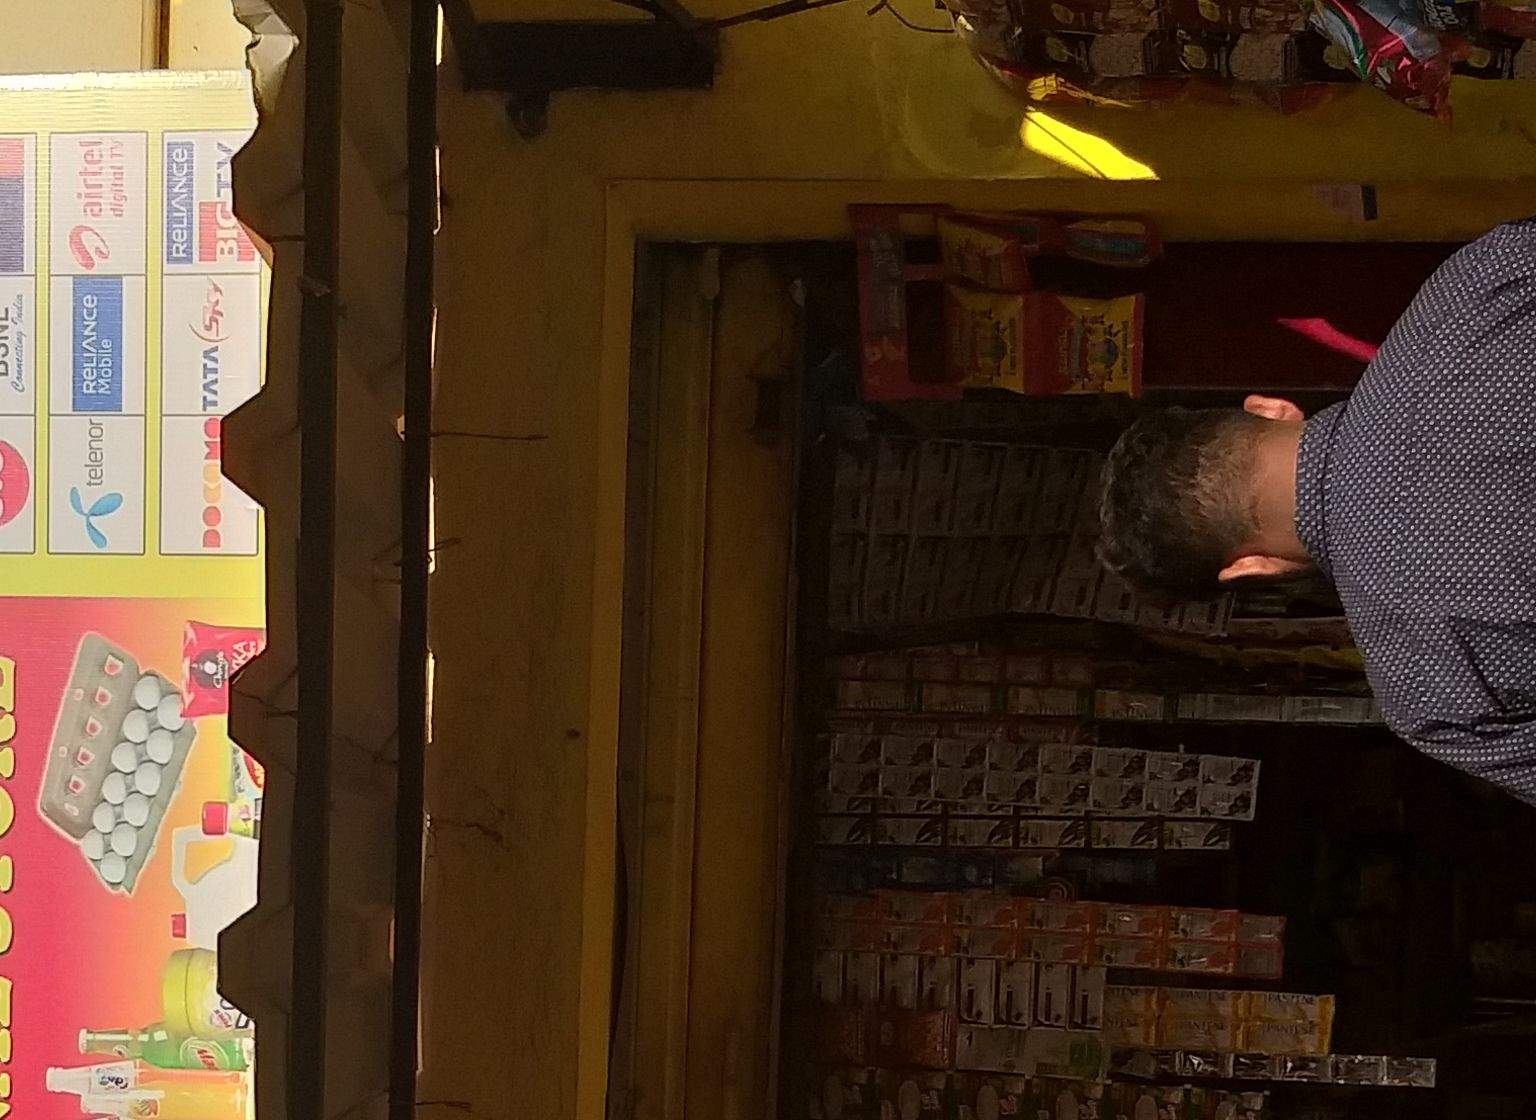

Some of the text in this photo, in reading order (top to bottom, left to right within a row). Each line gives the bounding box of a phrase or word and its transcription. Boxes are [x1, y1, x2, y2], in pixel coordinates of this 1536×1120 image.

[77, 140, 105, 218] airtel
[109, 140, 128, 218] digital TV
[215, 202, 237, 258] BIG
[10, 293, 27, 393] Connecting India
[98, 338, 114, 394] Mobile
[202, 344, 219, 411] TATA
[83, 418, 105, 487] telenor
[202, 417, 222, 548] DOCOMO
